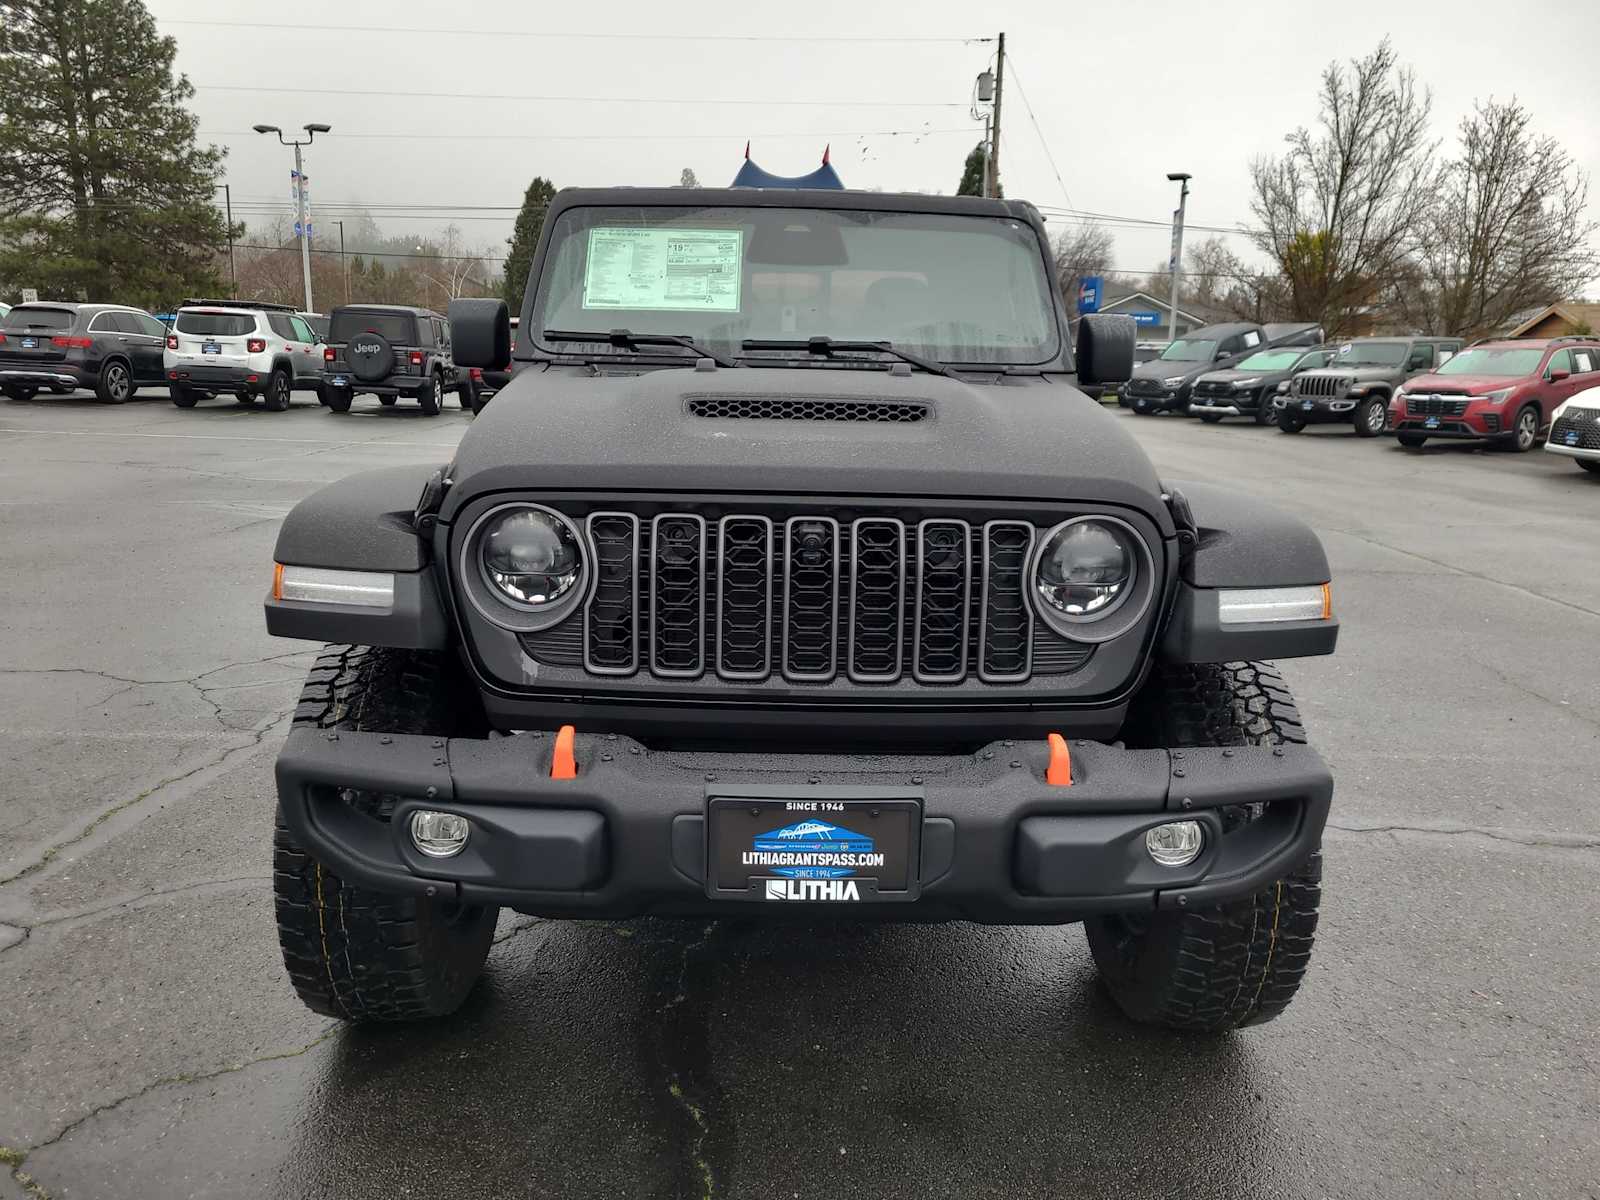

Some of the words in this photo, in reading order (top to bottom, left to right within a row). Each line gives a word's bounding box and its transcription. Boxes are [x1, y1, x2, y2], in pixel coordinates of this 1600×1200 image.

[354, 343, 380, 354] Jeep
[786, 802, 817, 811] SINCE
[821, 802, 844, 811] 1946
[742, 852, 884, 866] LITHIAGRANTSPASS.COM
[794, 869, 813, 878] SINCE
[787, 880, 860, 900] LITHIA
